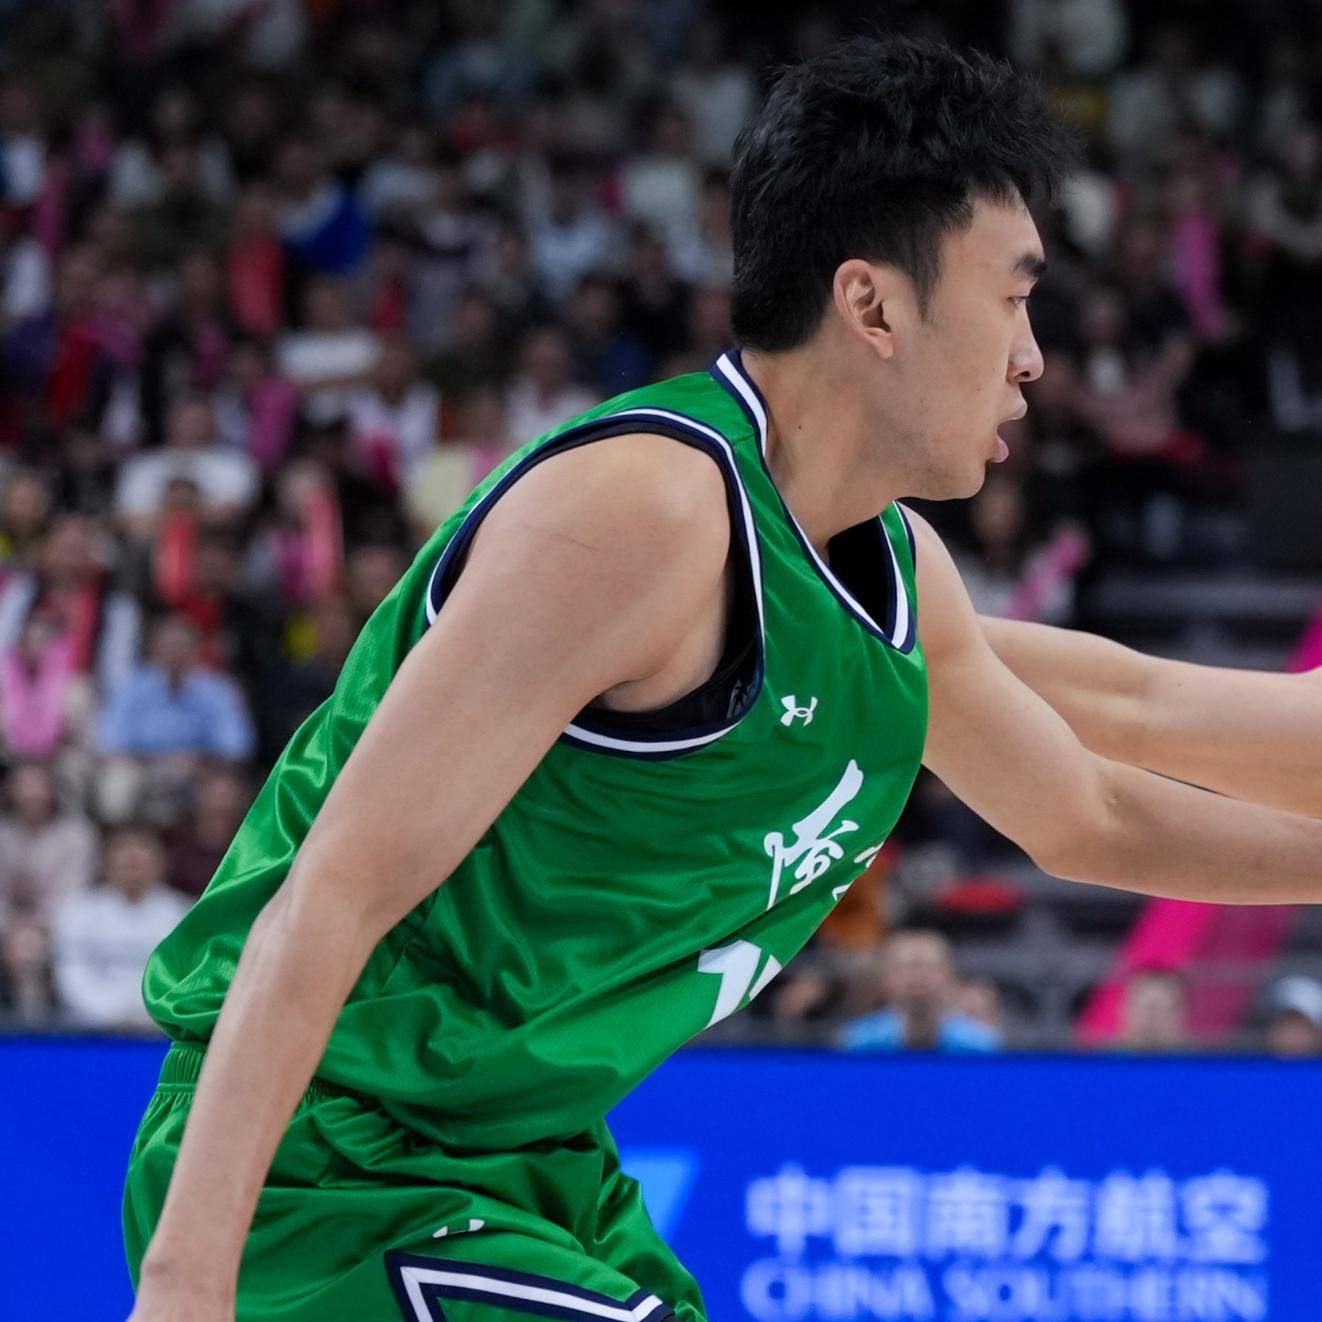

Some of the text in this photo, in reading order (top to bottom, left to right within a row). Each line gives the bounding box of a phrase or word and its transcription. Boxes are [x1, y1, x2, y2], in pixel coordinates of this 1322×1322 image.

[697, 939, 783, 1030] 1
[744, 1163, 1268, 1264] 中国南方航空
